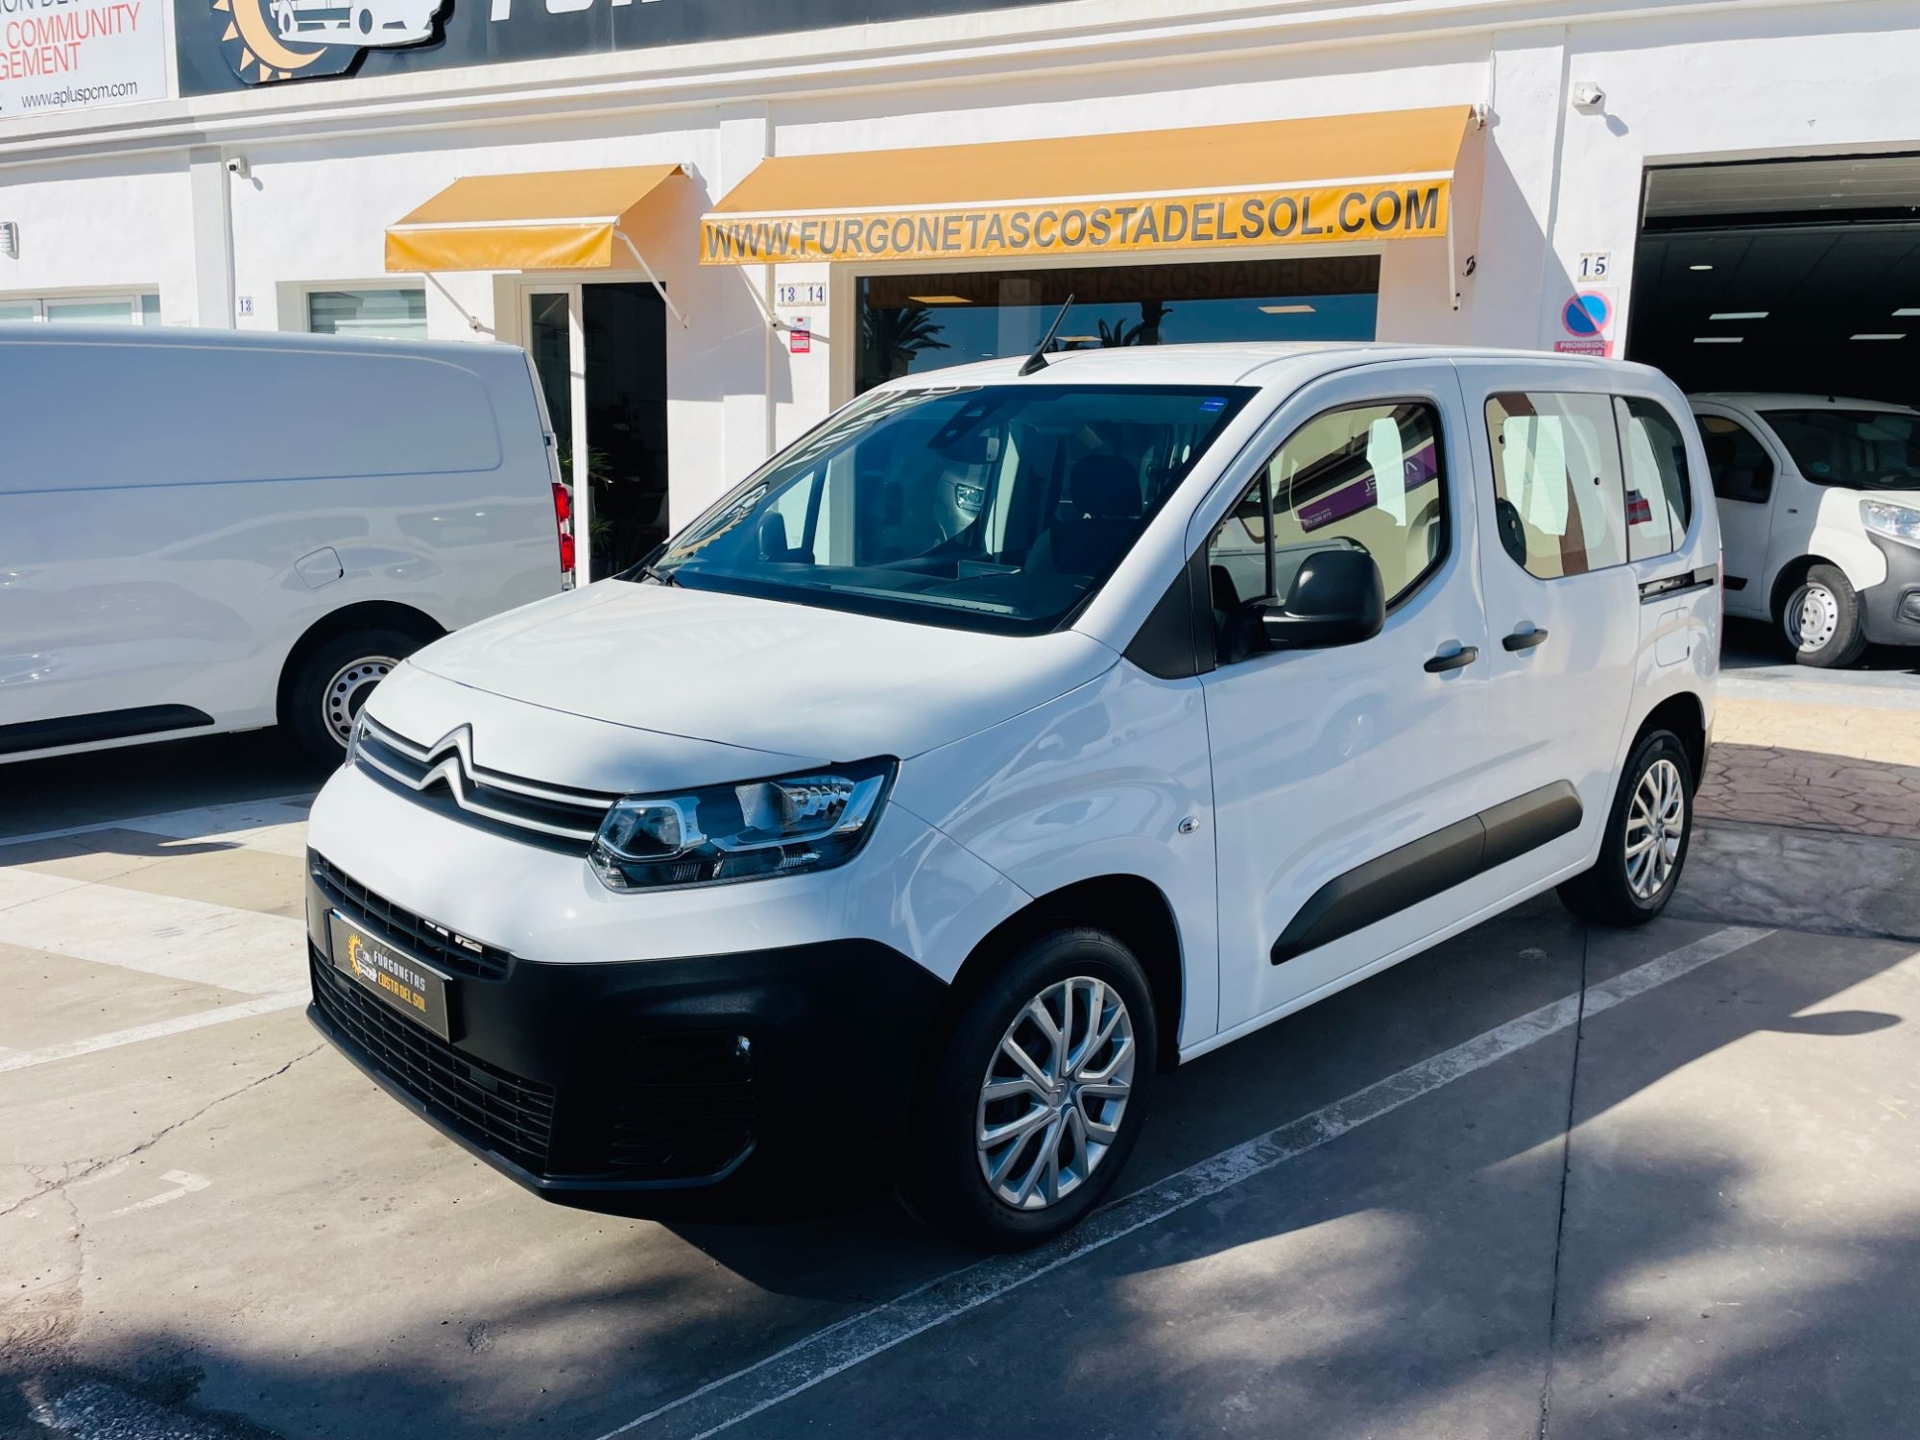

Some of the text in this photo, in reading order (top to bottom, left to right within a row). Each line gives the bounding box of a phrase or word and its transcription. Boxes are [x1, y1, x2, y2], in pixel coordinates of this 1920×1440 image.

[6, 2, 140, 49] COMMUNITY
[21, 81, 138, 108] www.apluspcm.com
[706, 187, 1440, 258] WWW.FURGONETASCOSTADELSOL.COM
[1581, 256, 1606, 276] 15
[780, 286, 823, 302] 13 14
[1560, 341, 1606, 349] PROHIBIDO
[373, 950, 426, 992] FURGONETAS
[378, 971, 427, 1012] COSTA DEL SOL
